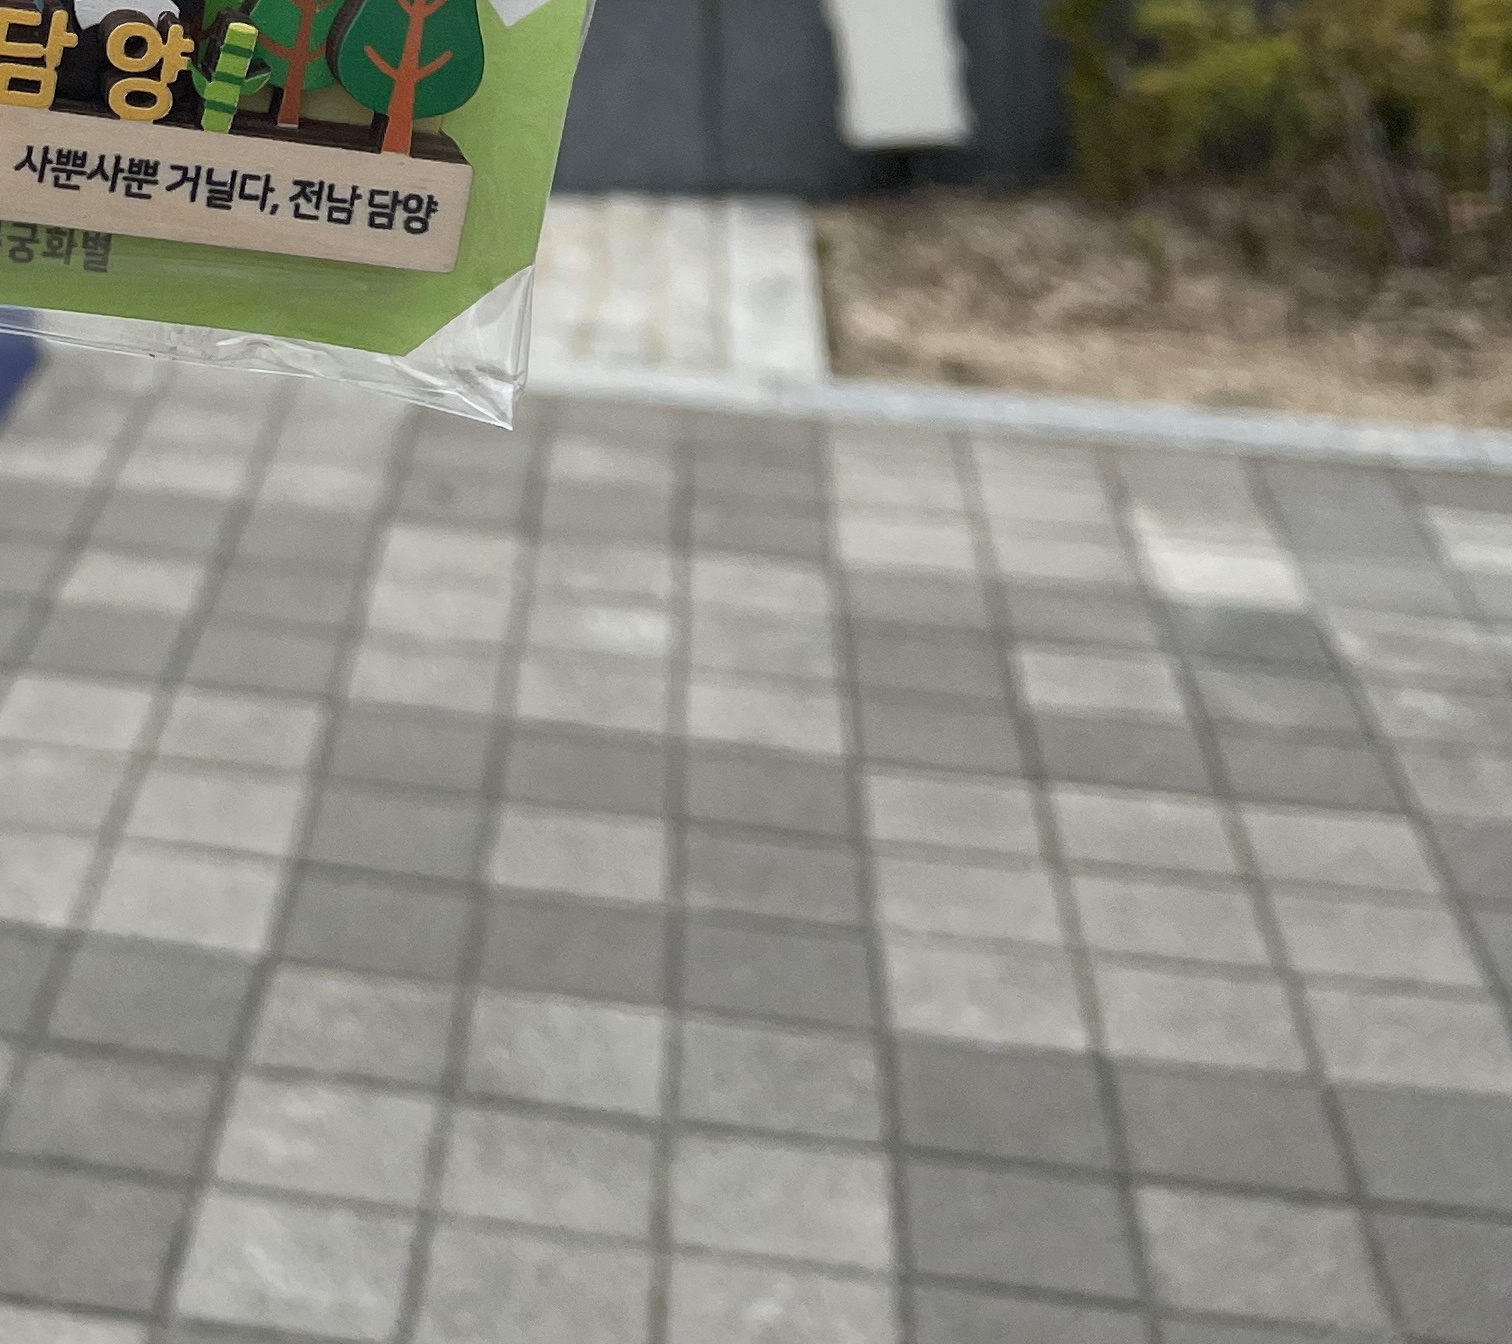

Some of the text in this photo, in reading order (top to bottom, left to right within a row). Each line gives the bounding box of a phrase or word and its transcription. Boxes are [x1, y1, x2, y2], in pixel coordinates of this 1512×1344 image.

[14, 145, 439, 235] 사뿐사뿐 거닐다, 전남 담양
